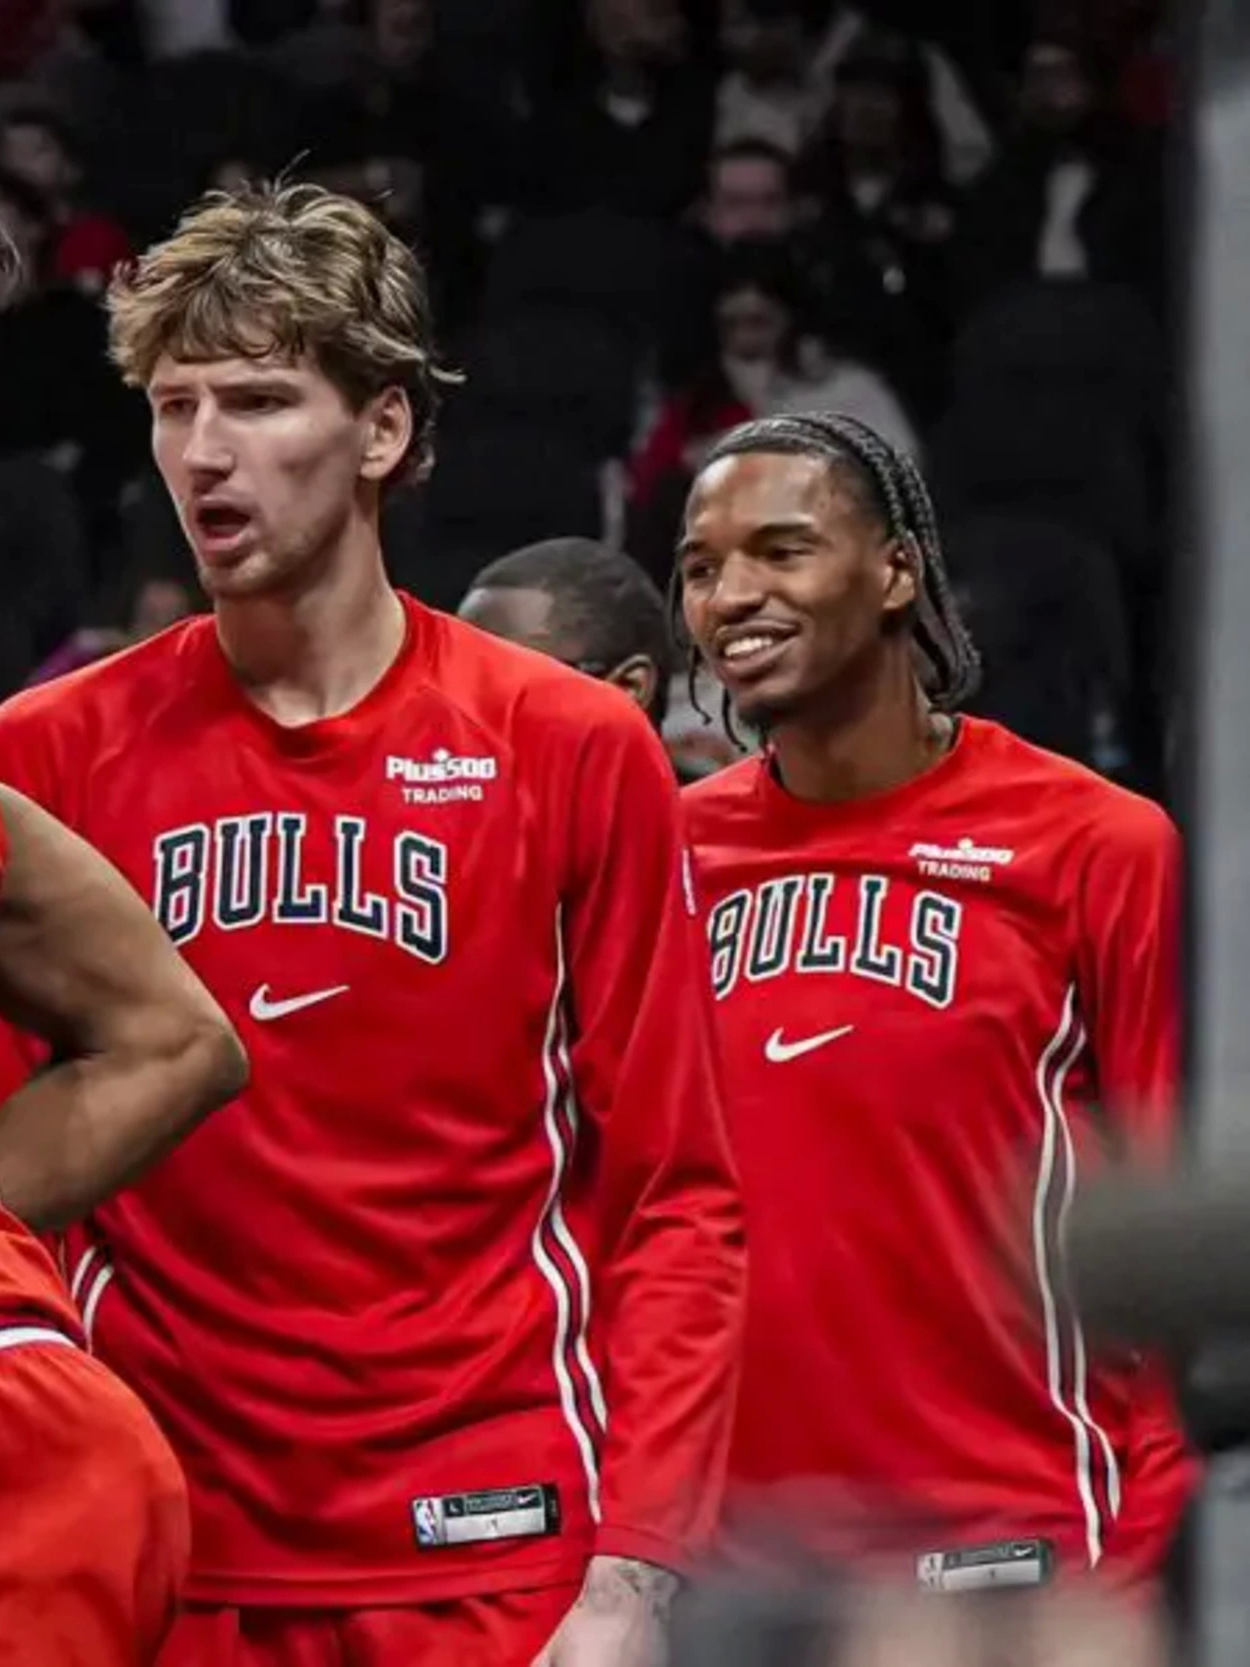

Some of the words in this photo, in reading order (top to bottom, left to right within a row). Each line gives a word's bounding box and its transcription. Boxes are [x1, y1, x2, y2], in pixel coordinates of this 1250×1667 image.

[386, 755, 497, 782] Plus500
[402, 785, 484, 804] TRADING
[918, 860, 991, 881] TRADING
[153, 811, 448, 965] BULLS
[707, 873, 962, 1010] BULLS
